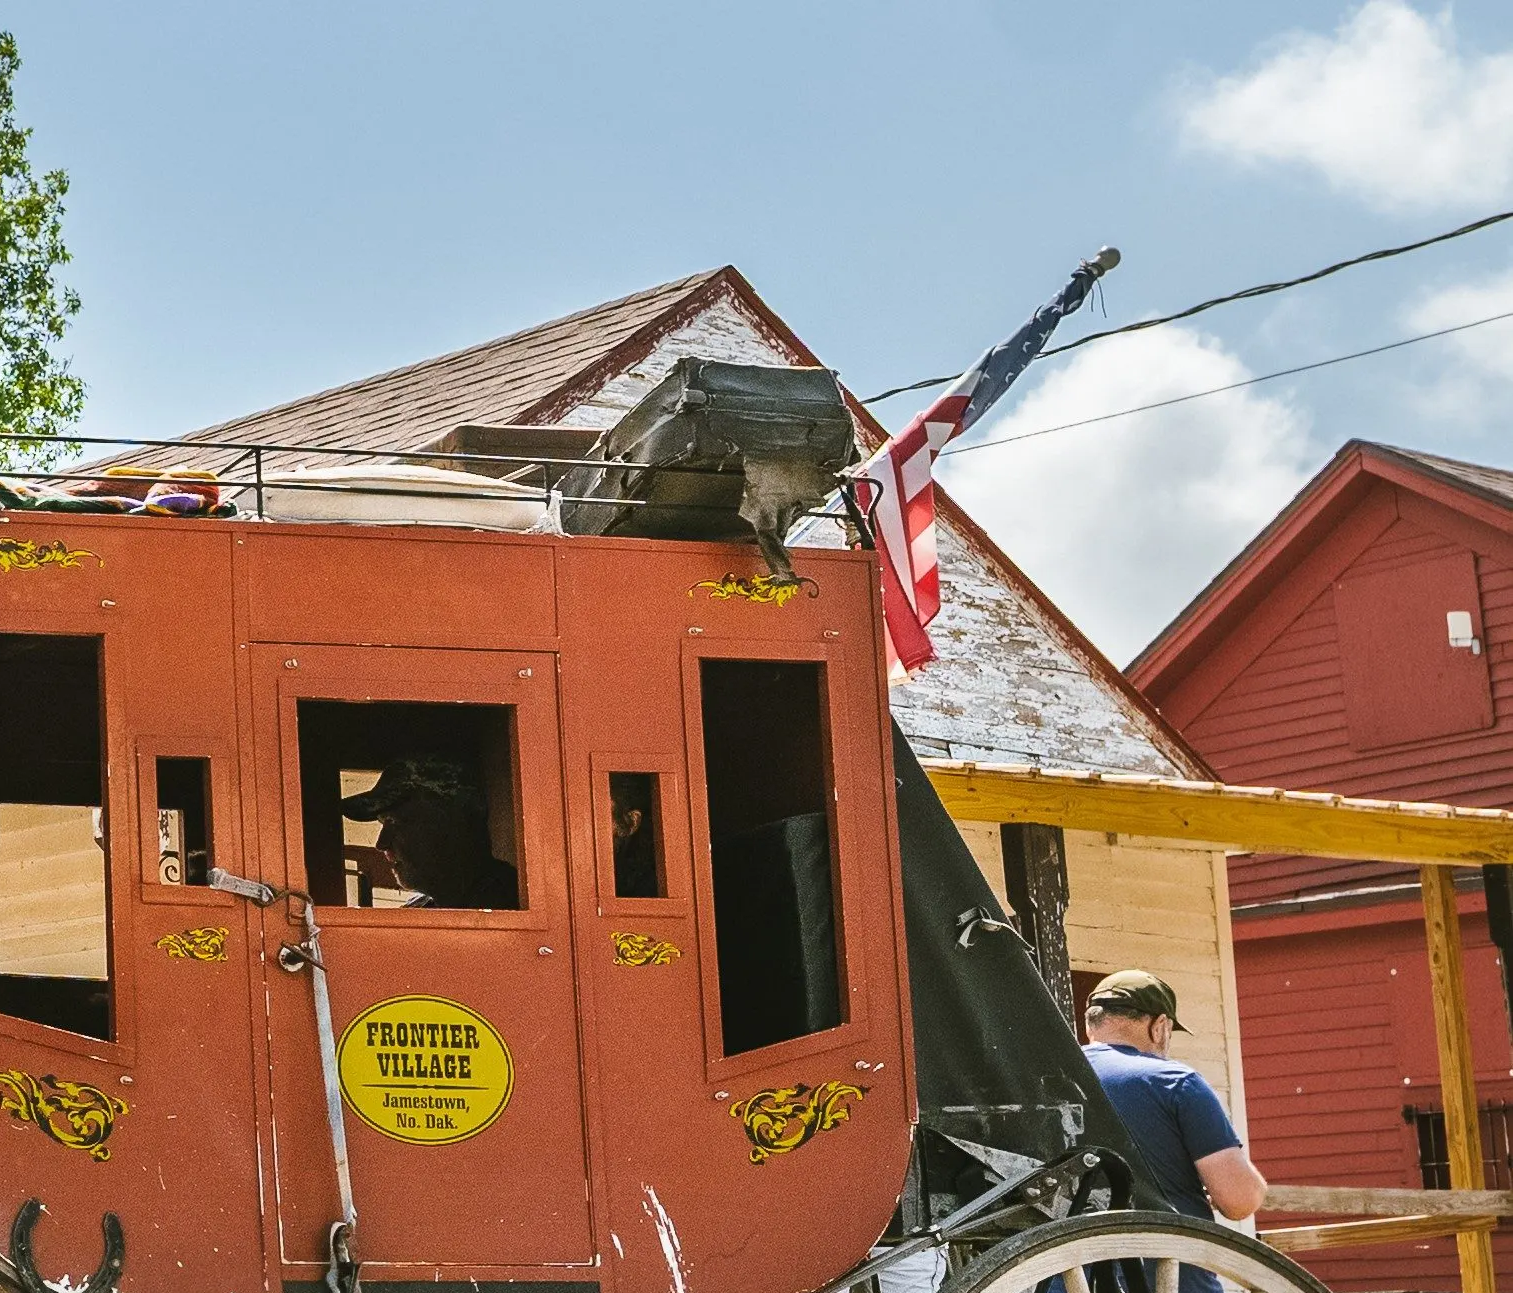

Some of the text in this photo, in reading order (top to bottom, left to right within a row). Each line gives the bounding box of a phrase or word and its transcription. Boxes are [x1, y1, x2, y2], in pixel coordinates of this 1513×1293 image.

[366, 1022, 480, 1049] FRONTIER
[376, 1053, 472, 1079] VILLAGE
[382, 1092, 470, 1113] Jamestown,
[396, 1113, 458, 1130] No. Dak.
